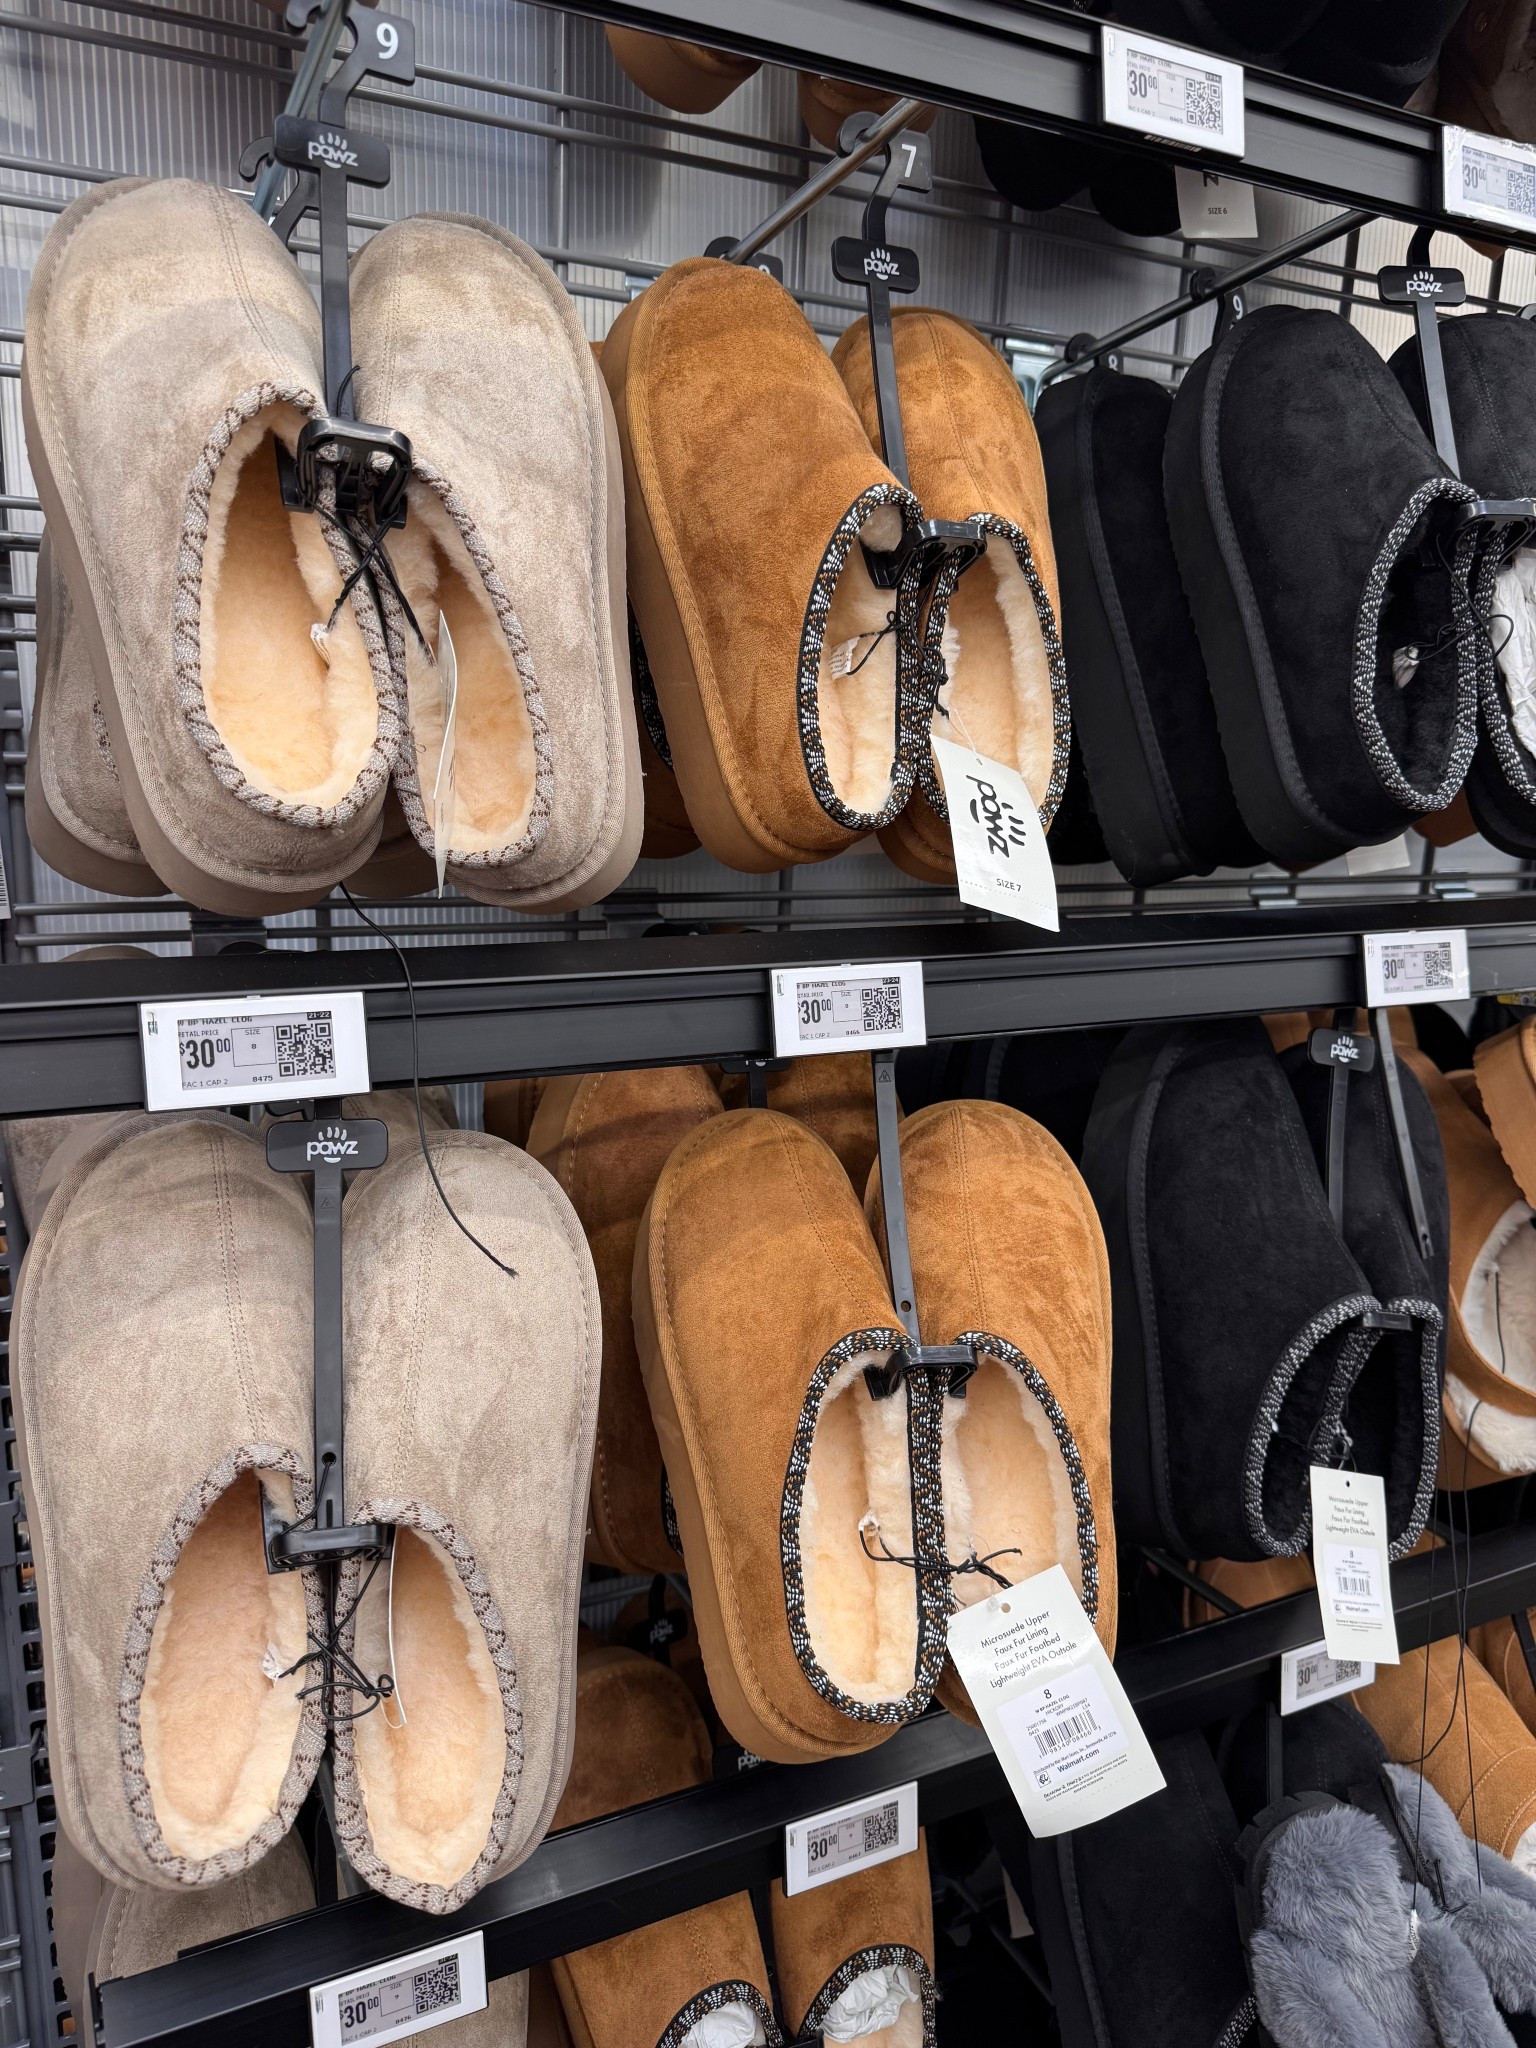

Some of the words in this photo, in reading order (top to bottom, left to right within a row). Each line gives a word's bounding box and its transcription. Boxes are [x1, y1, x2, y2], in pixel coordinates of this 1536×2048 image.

[376, 22, 399, 60] 9
[902, 143, 917, 178] 7
[1232, 295, 1243, 320] 9
[996, 878, 1015, 891] SIZE
[202, 1017, 227, 1025] HAZEL
[307, 1141, 359, 1161] pawz
[981, 1622, 1025, 1649] Microsuede
[1025, 1610, 1050, 1627] Upper
[994, 1643, 1013, 1657] Faux
[1013, 1636, 1026, 1648] Fur
[1026, 1626, 1049, 1641] Lining
[990, 1664, 1031, 1688] Lightweight
[1030, 1655, 1049, 1668] EVA
[1048, 1641, 1078, 1659] Outsole
[994, 1659, 1015, 1671] Faux
[1015, 1650, 1028, 1661] Fur
[1028, 1633, 1061, 1655] Footbed
[1044, 1689, 1052, 1699] 8
[737, 1751, 767, 1772] paw
[1057, 1748, 1100, 1772] Walmart.com
